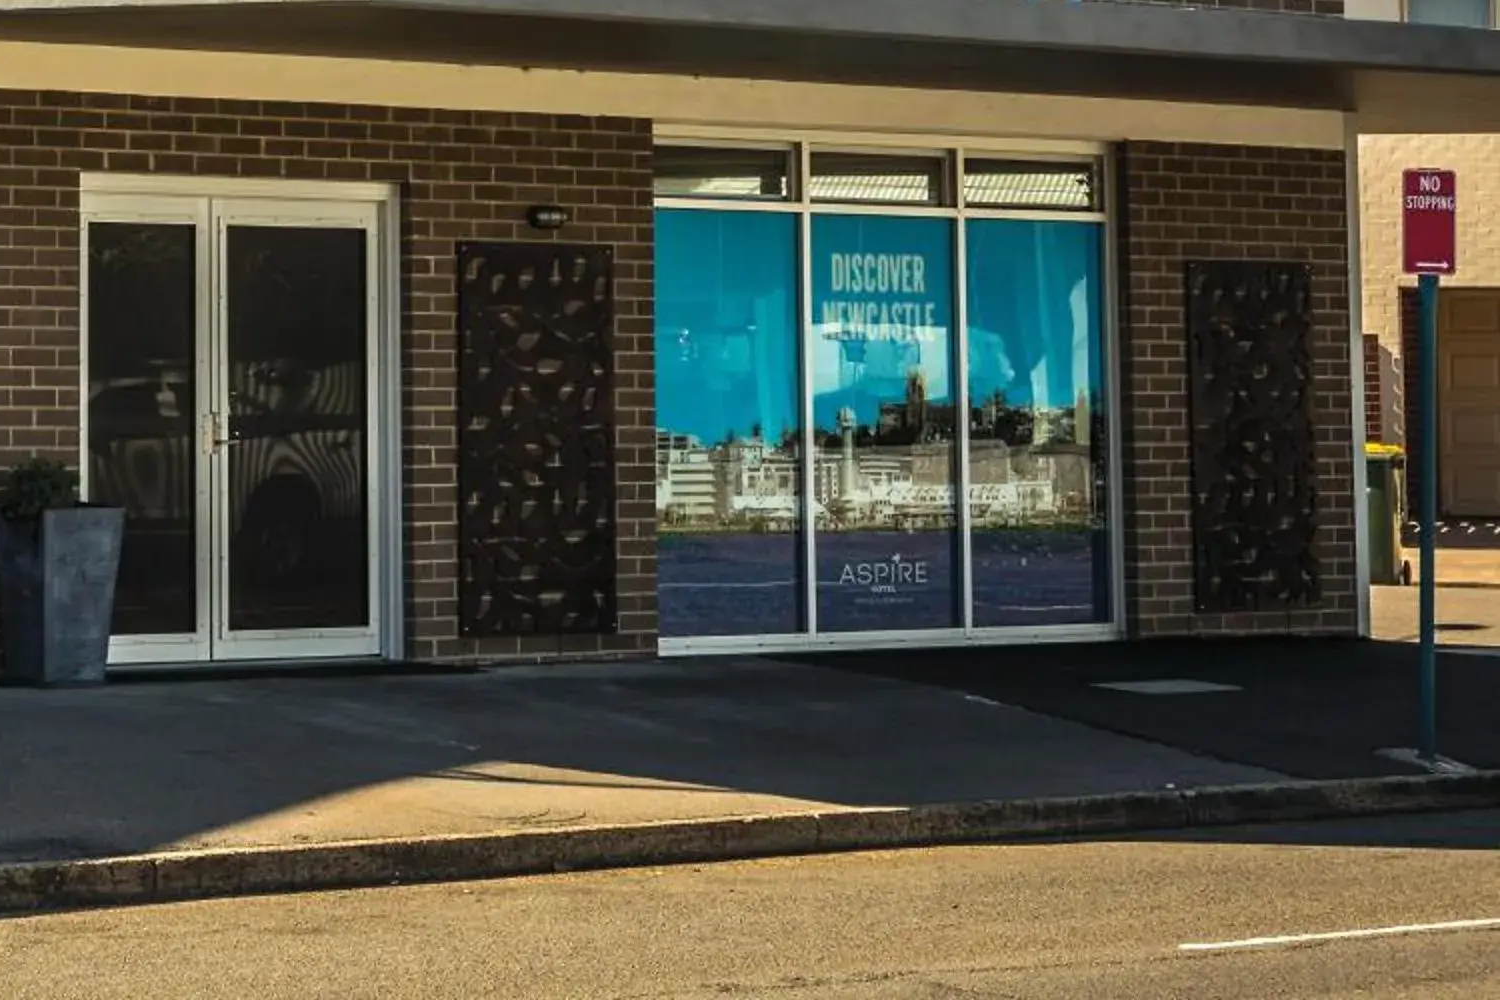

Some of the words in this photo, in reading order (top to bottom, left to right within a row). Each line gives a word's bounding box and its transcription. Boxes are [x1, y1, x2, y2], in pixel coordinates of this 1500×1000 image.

[1419, 175, 1441, 192] NO
[1406, 195, 1454, 210] STOPPING
[831, 253, 925, 293] DISCOVER
[823, 301, 935, 341] NEWCASTLE
[839, 562, 928, 584] ASPIRE
